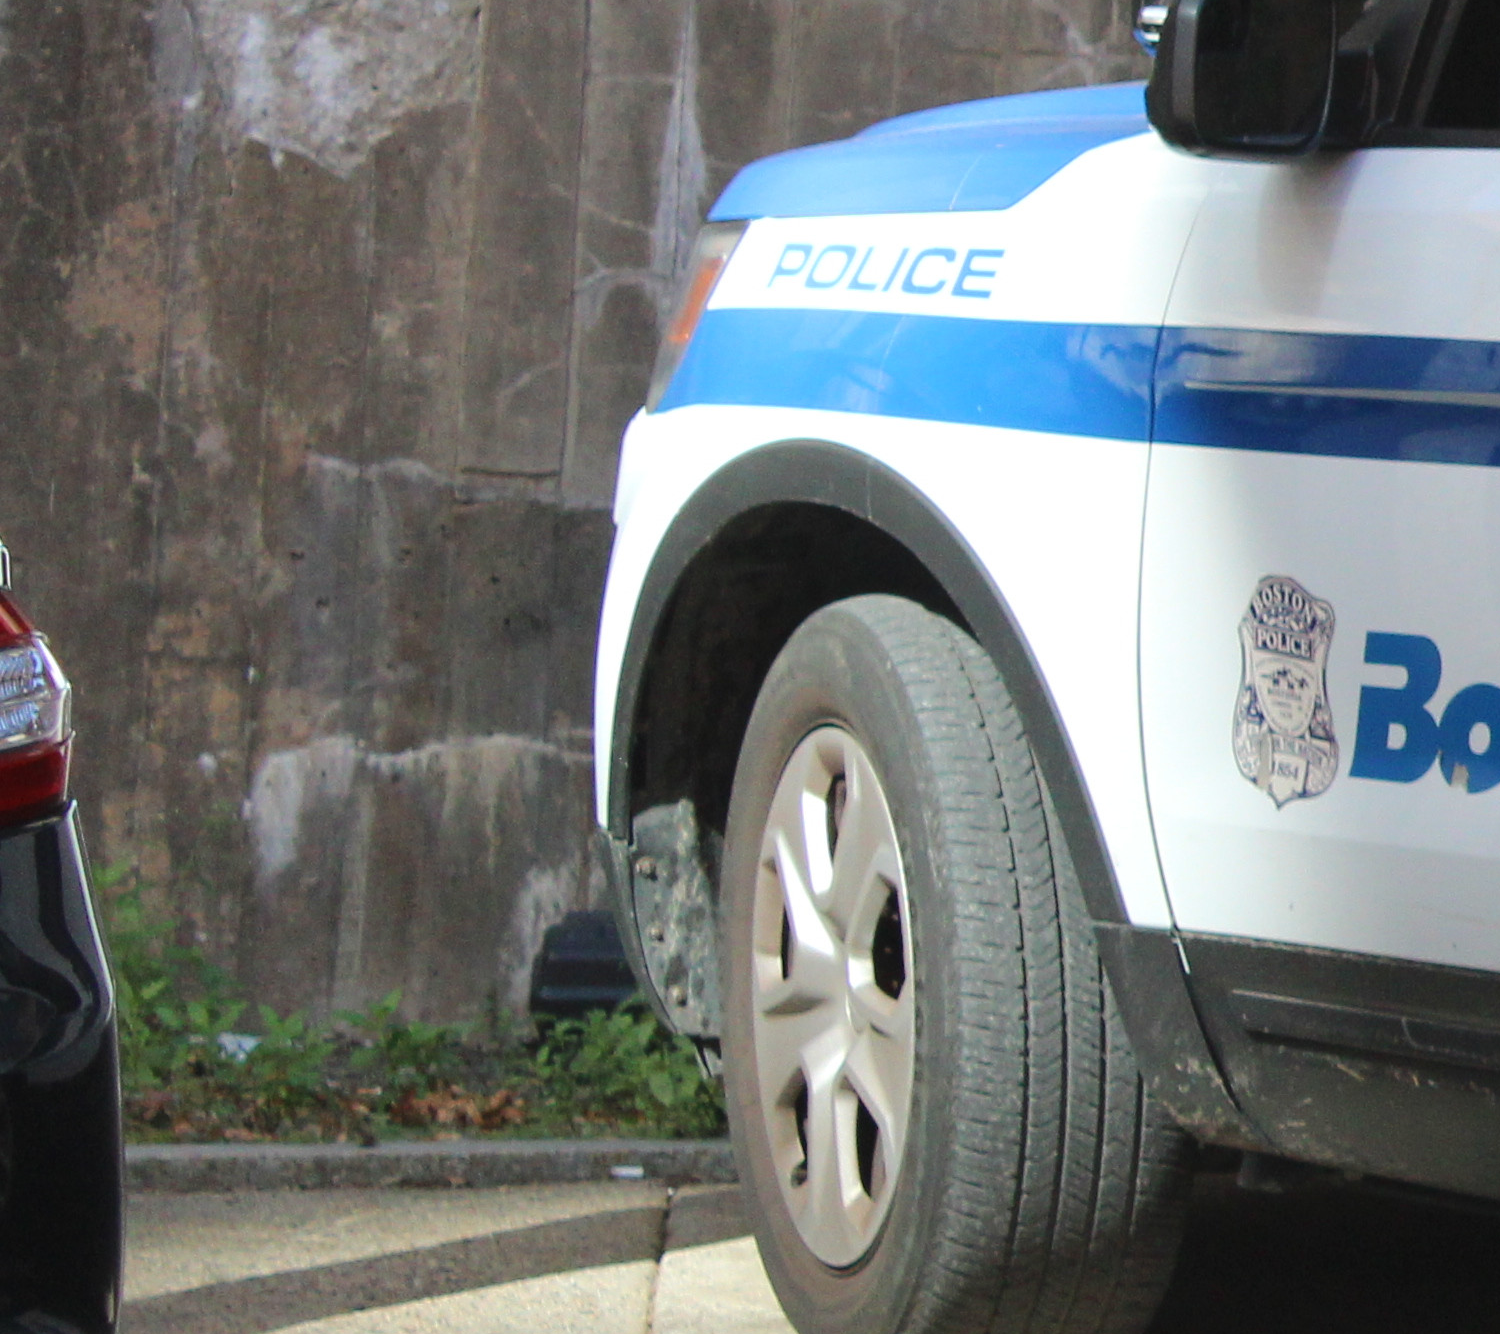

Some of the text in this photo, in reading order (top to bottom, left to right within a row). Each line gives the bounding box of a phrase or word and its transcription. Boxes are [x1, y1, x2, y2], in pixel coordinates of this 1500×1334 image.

[766, 243, 1006, 299] POLICE
[1250, 583, 1318, 631] BOSTON
[1257, 627, 1312, 657] POLICE
